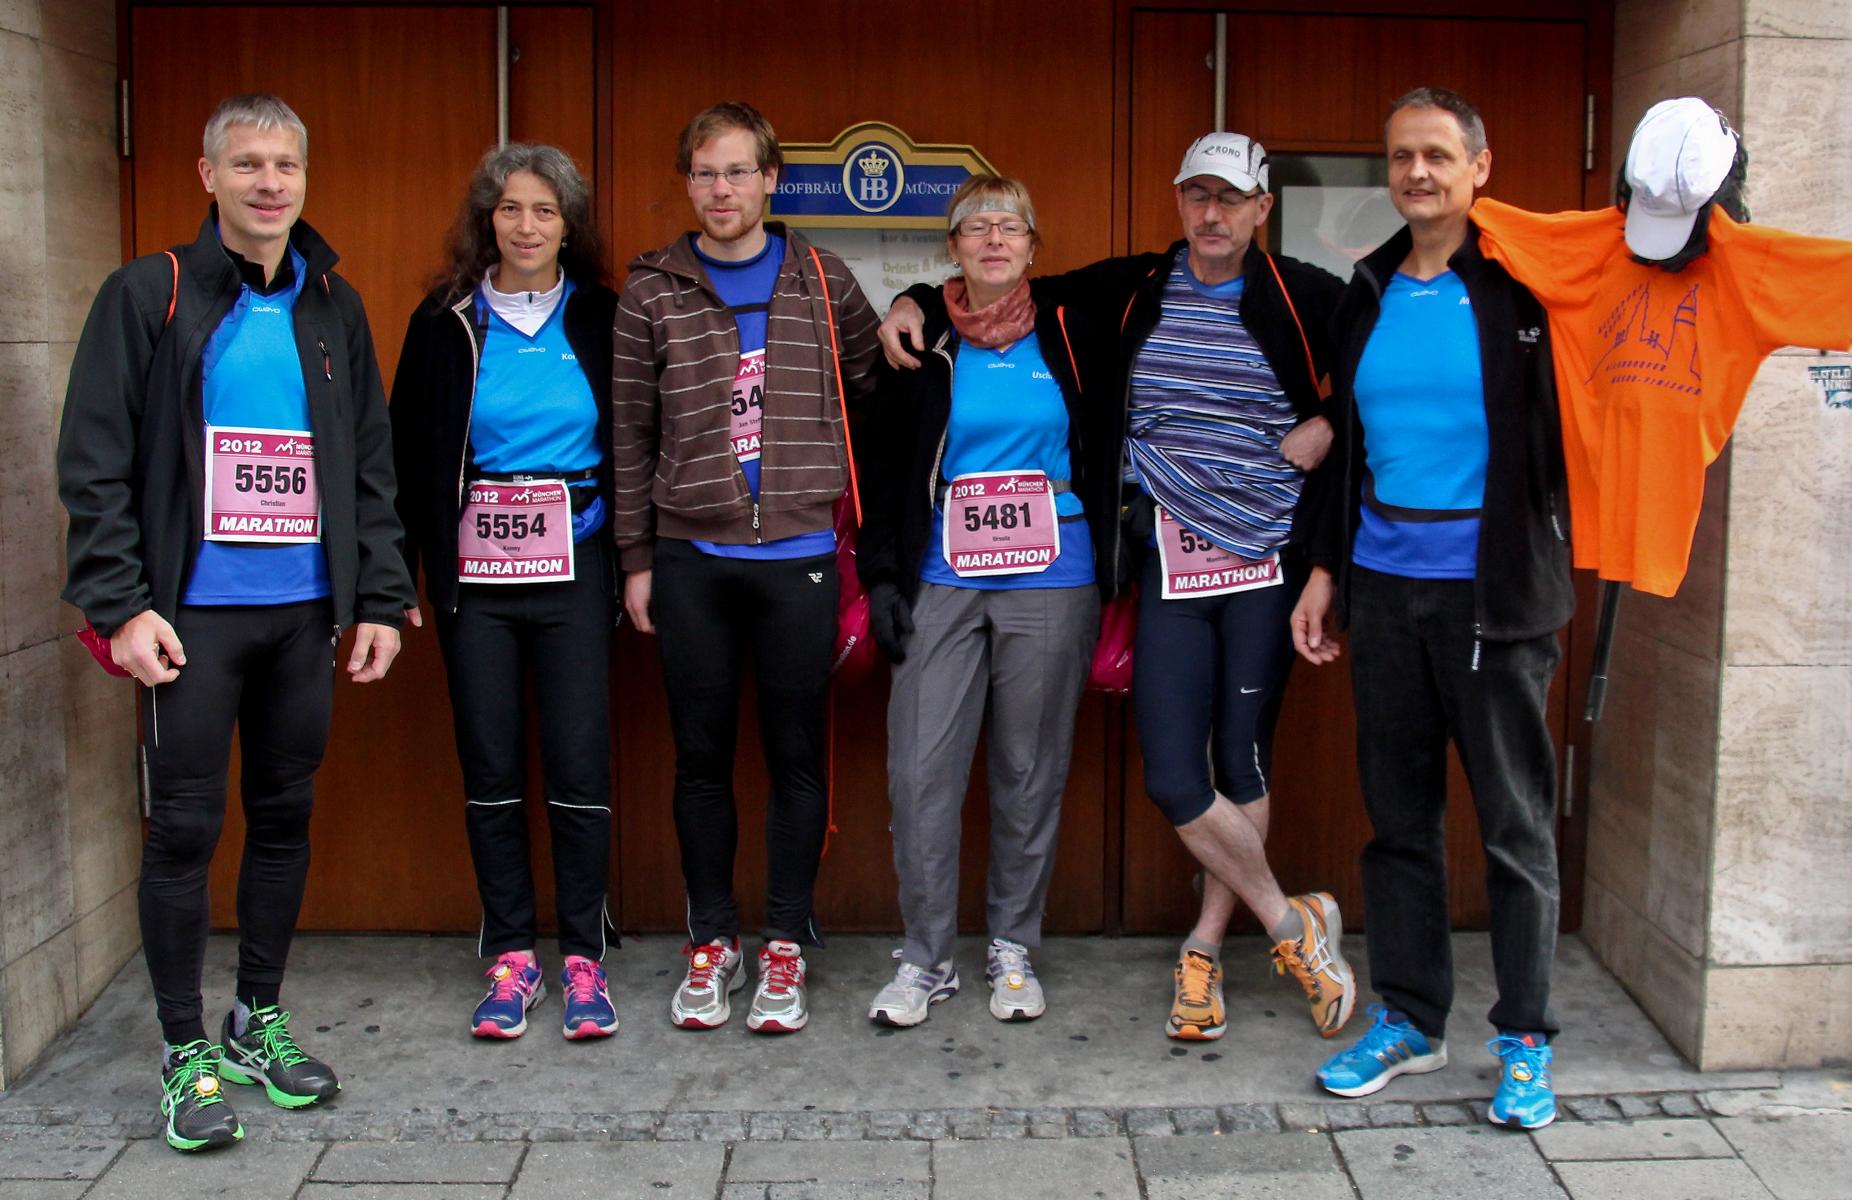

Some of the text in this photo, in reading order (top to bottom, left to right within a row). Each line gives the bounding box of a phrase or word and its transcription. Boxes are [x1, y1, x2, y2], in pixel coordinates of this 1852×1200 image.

[774, 180, 842, 195] HOFBRÄU
[859, 177, 889, 201] HB
[219, 438, 262, 454] 2012
[731, 435, 762, 454] RA
[235, 464, 307, 495] 5556
[470, 490, 499, 503] 2012
[955, 483, 986, 498] 2012
[218, 516, 314, 533] MARATHON
[476, 512, 547, 540] 5554
[964, 502, 1032, 532] 5481
[464, 559, 563, 575] MARATHON
[956, 549, 1051, 568] MARATHON
[1175, 564, 1270, 590] MARATHON
